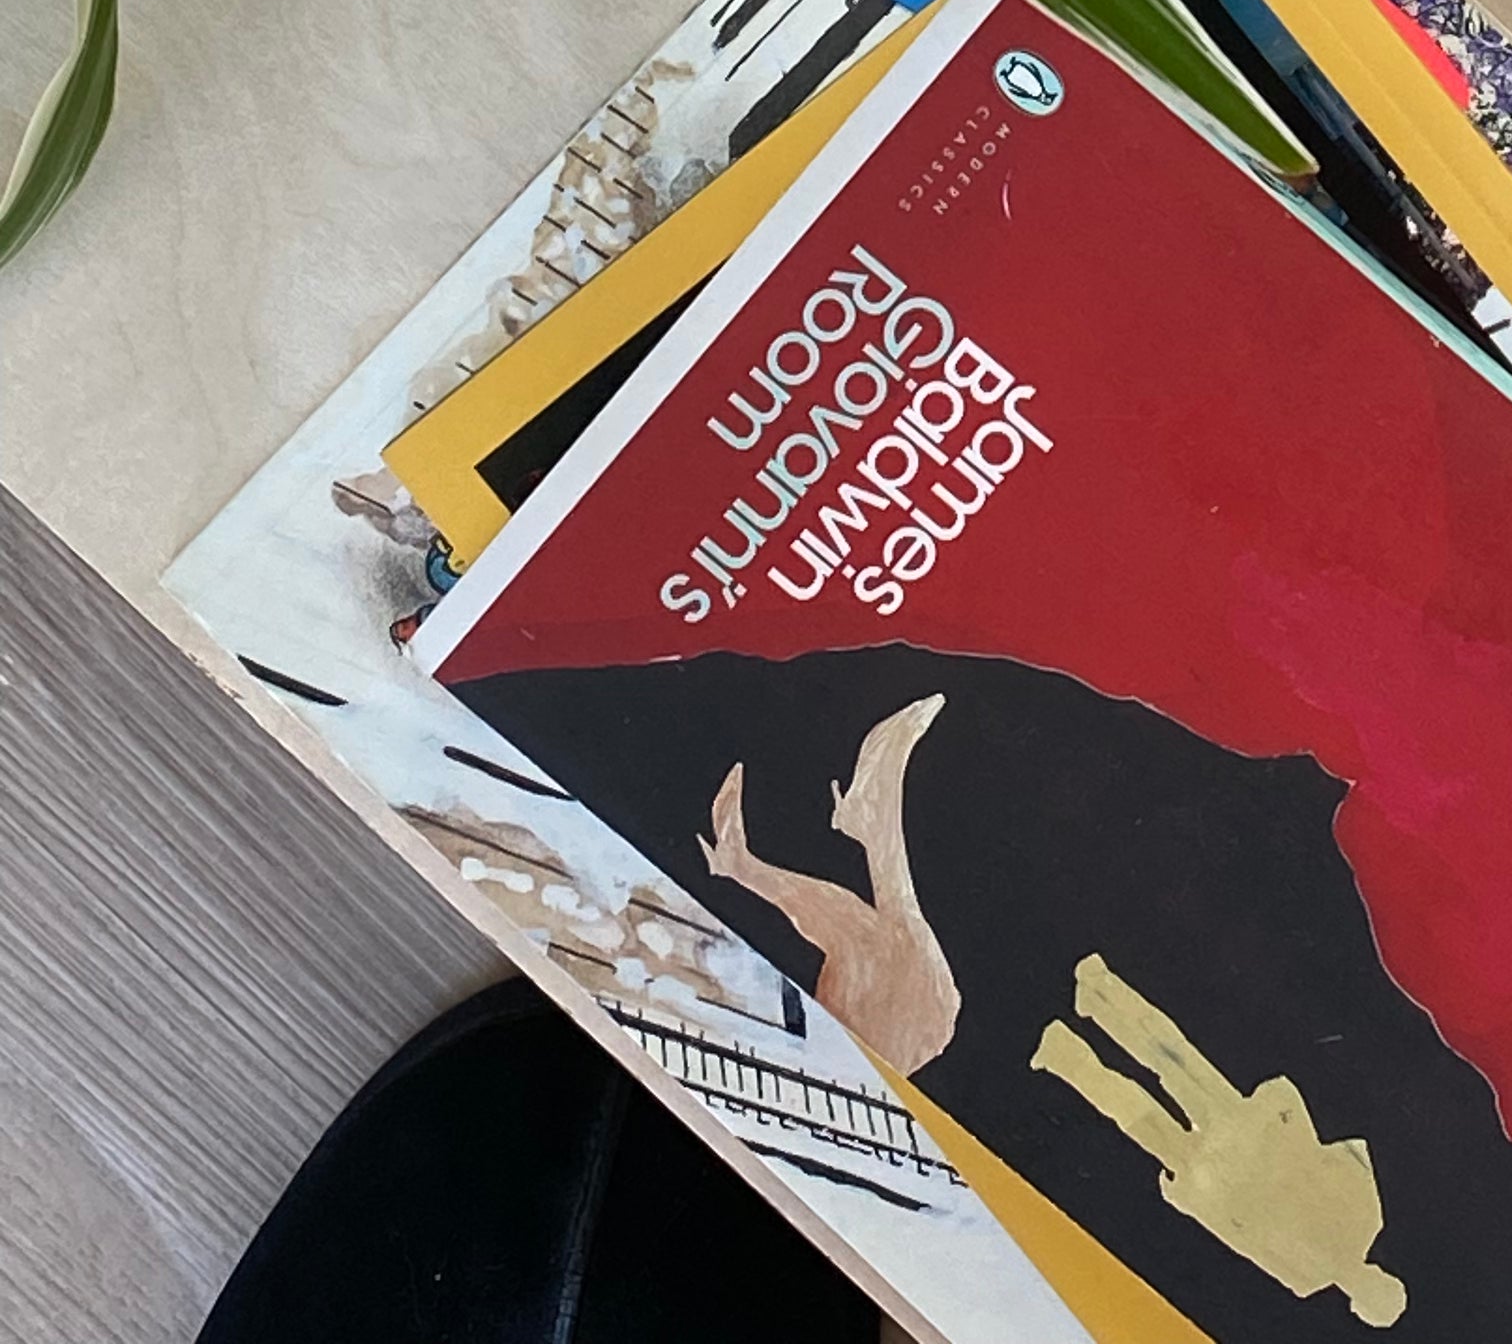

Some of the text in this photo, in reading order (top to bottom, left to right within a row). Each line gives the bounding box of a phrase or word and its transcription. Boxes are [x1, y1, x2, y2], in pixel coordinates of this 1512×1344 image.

[898, 106, 990, 212] CLASSICS
[932, 123, 1011, 215] MODERN
[706, 244, 908, 450] Room
[659, 296, 956, 623] Giovanni's
[767, 337, 1016, 601] Baldwin
[854, 385, 1054, 616] James
